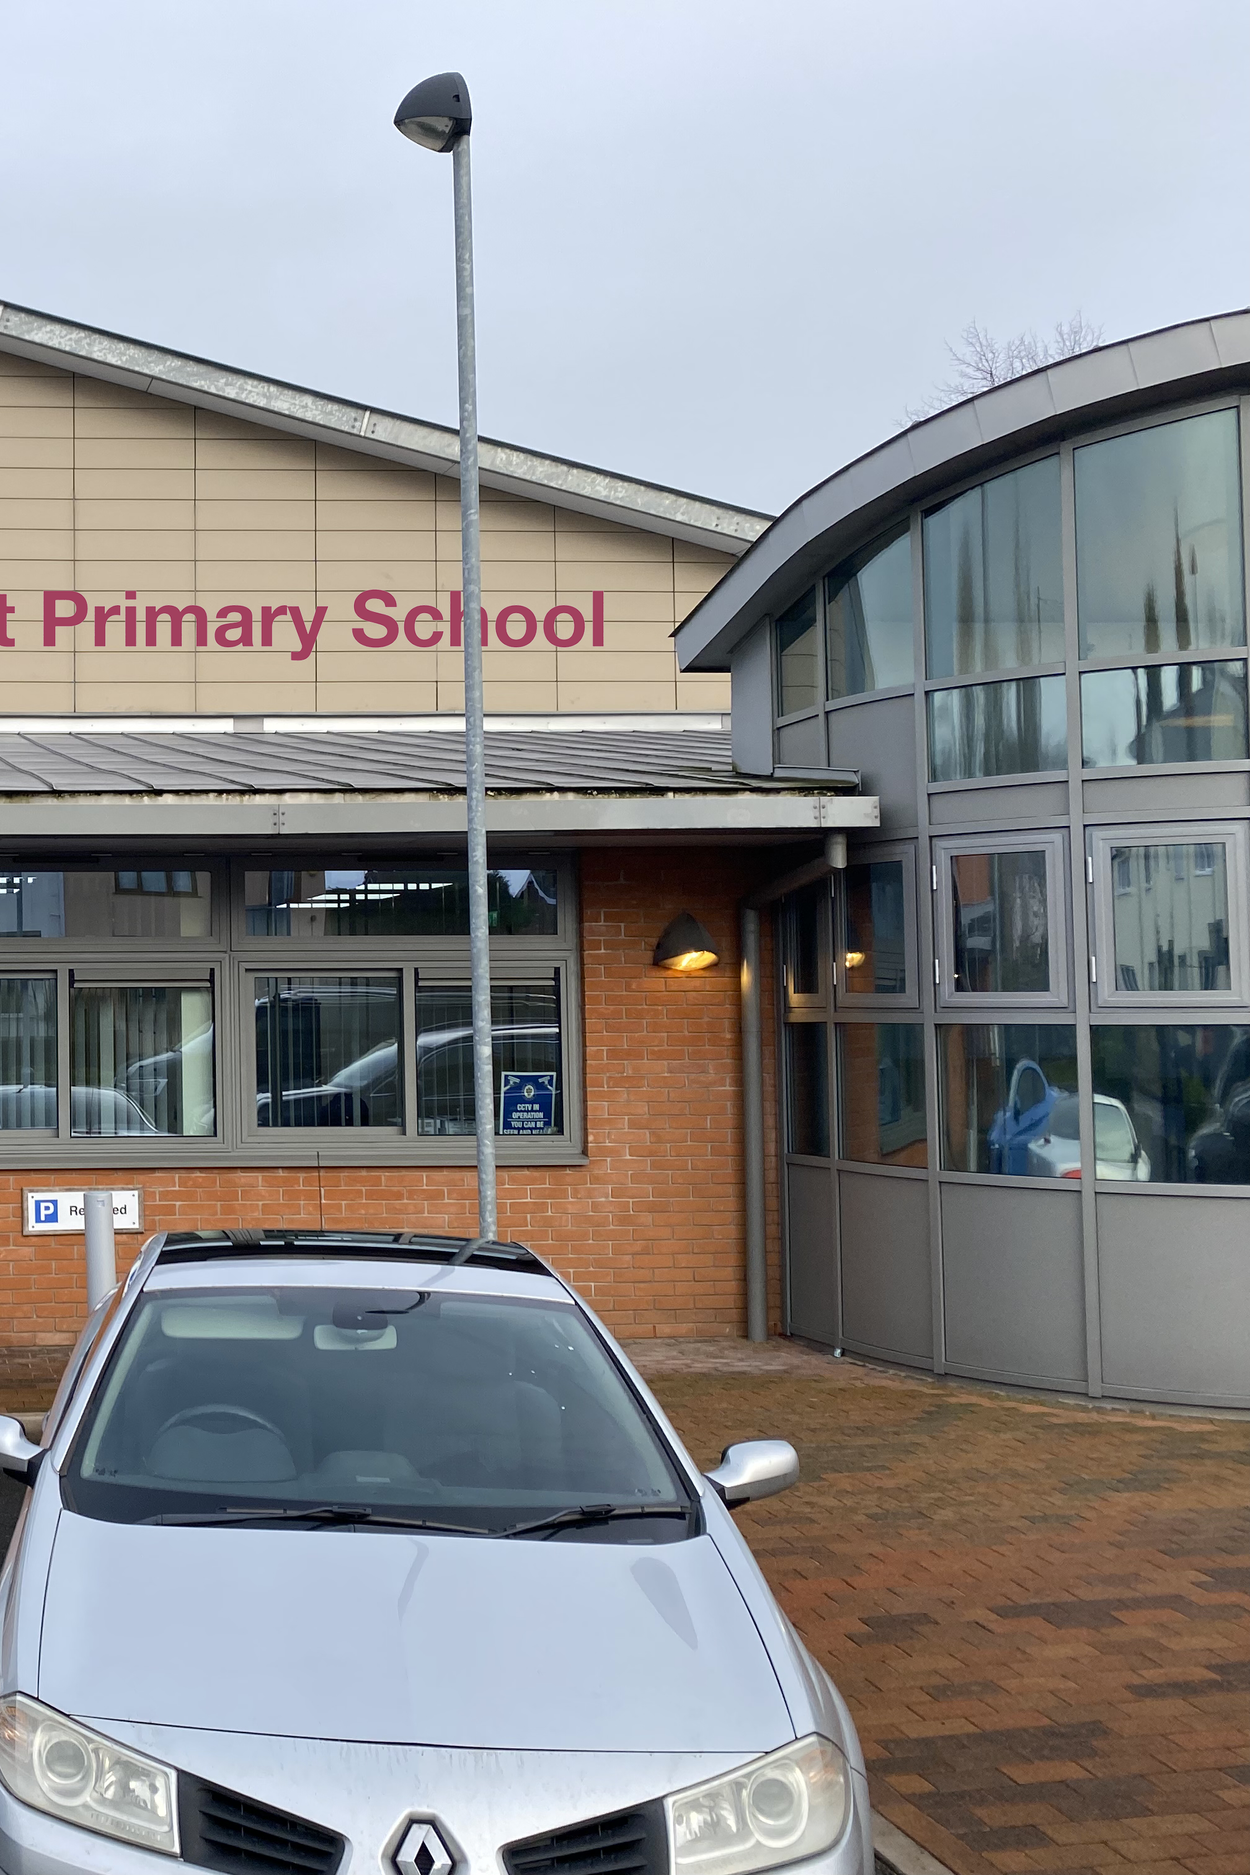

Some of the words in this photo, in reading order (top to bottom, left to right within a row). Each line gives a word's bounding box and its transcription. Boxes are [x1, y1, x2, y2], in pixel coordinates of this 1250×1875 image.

[43, 590, 329, 661] Primary
[351, 589, 605, 649] School
[69, 1204, 128, 1217] Reed
